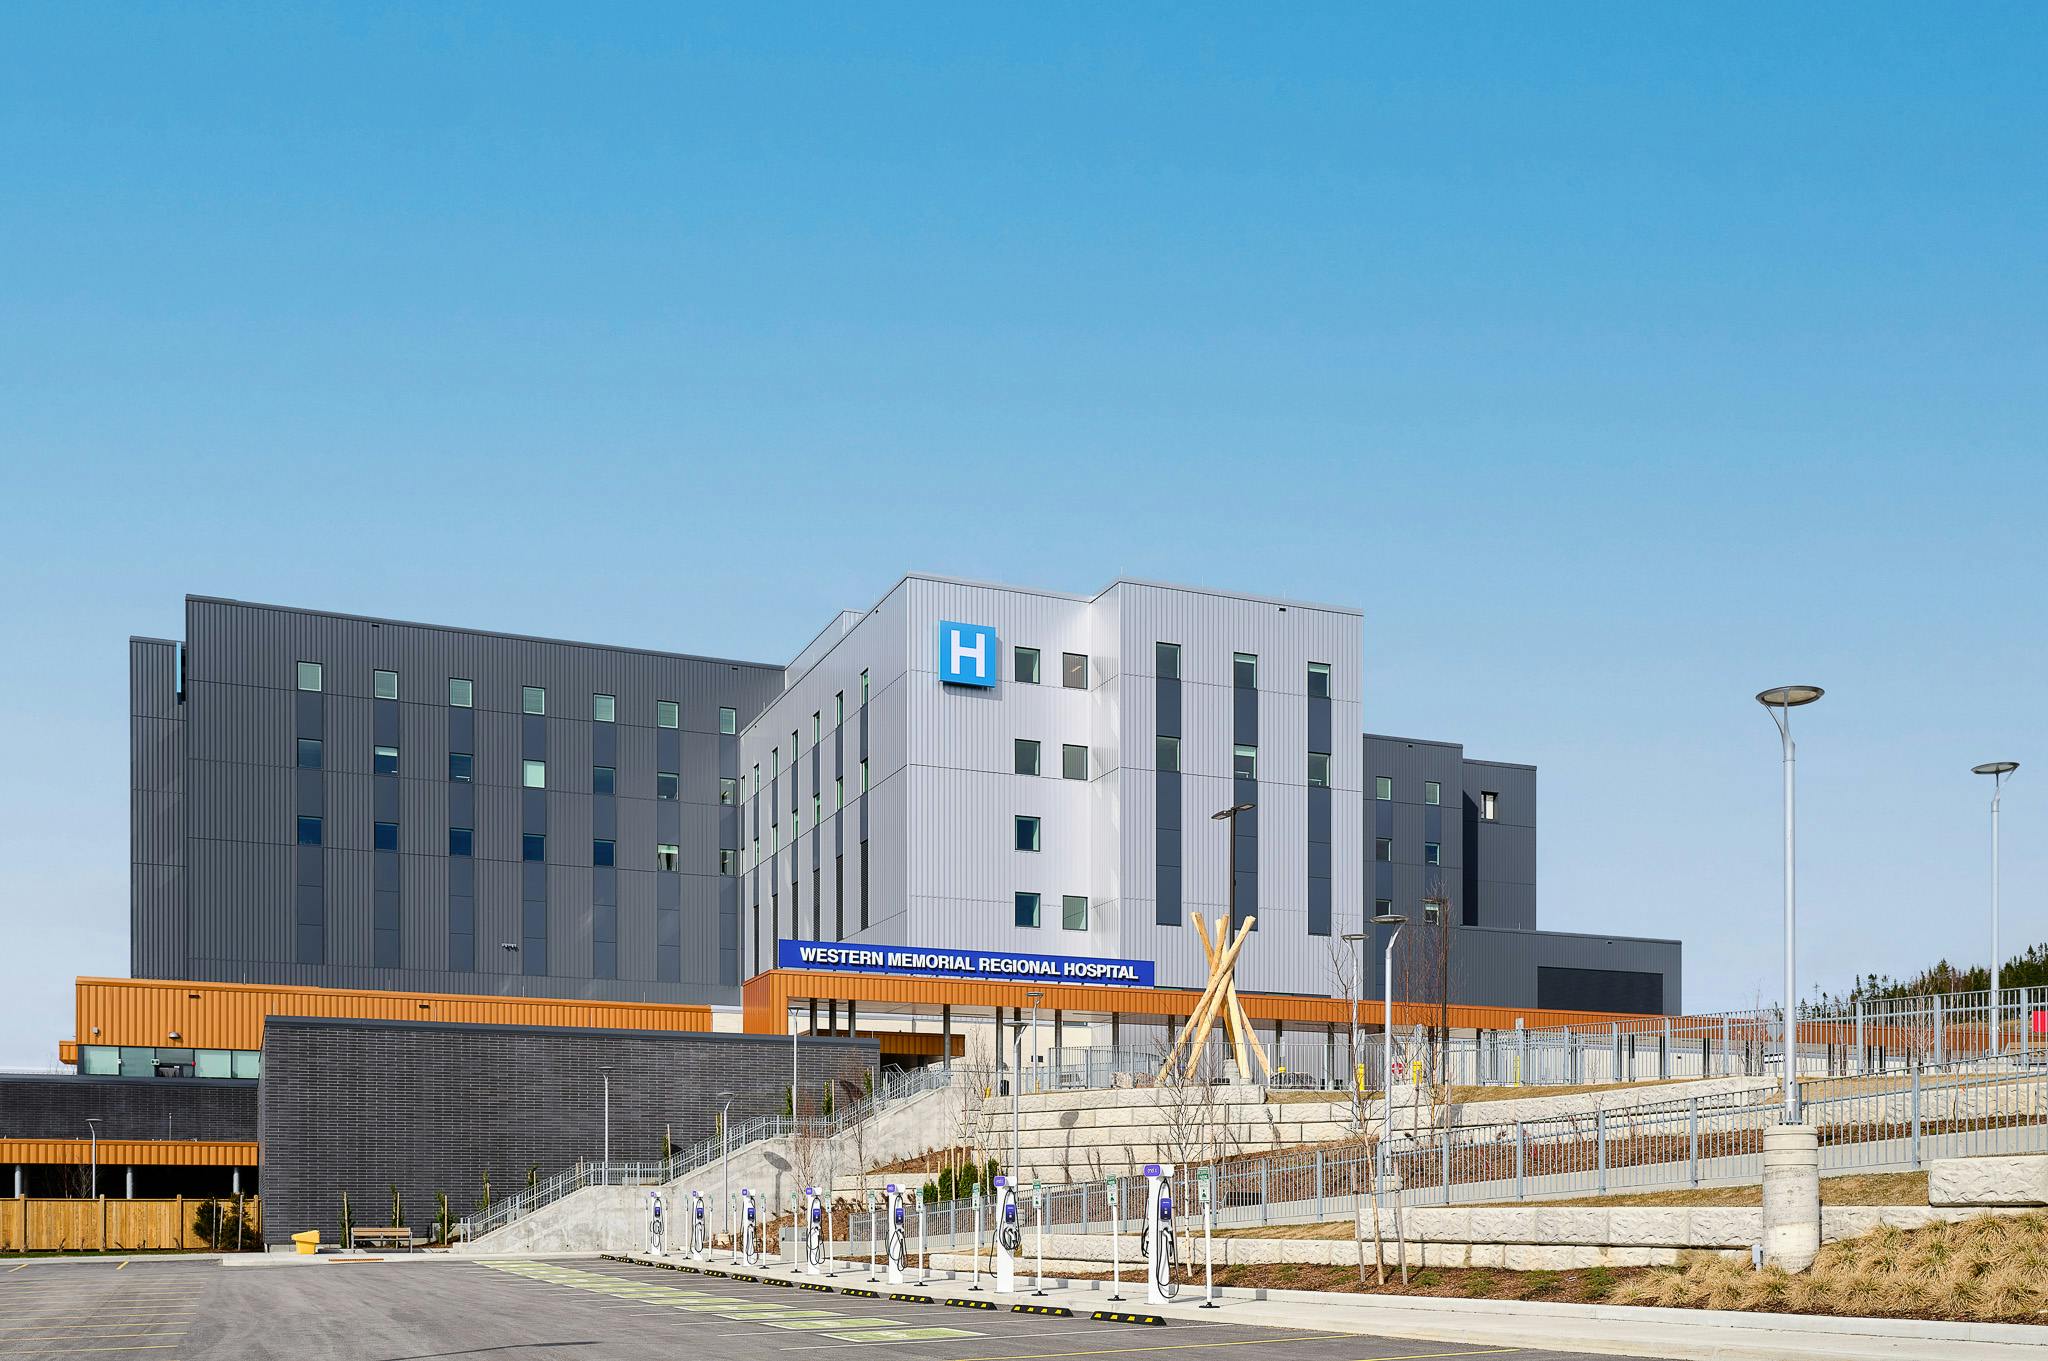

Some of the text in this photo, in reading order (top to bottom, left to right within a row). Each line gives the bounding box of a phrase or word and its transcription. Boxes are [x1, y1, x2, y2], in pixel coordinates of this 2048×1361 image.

[951, 629, 985, 678] H
[800, 947, 1139, 980] WESTERN MEMORIAL REGIONAL HOSPITAL
